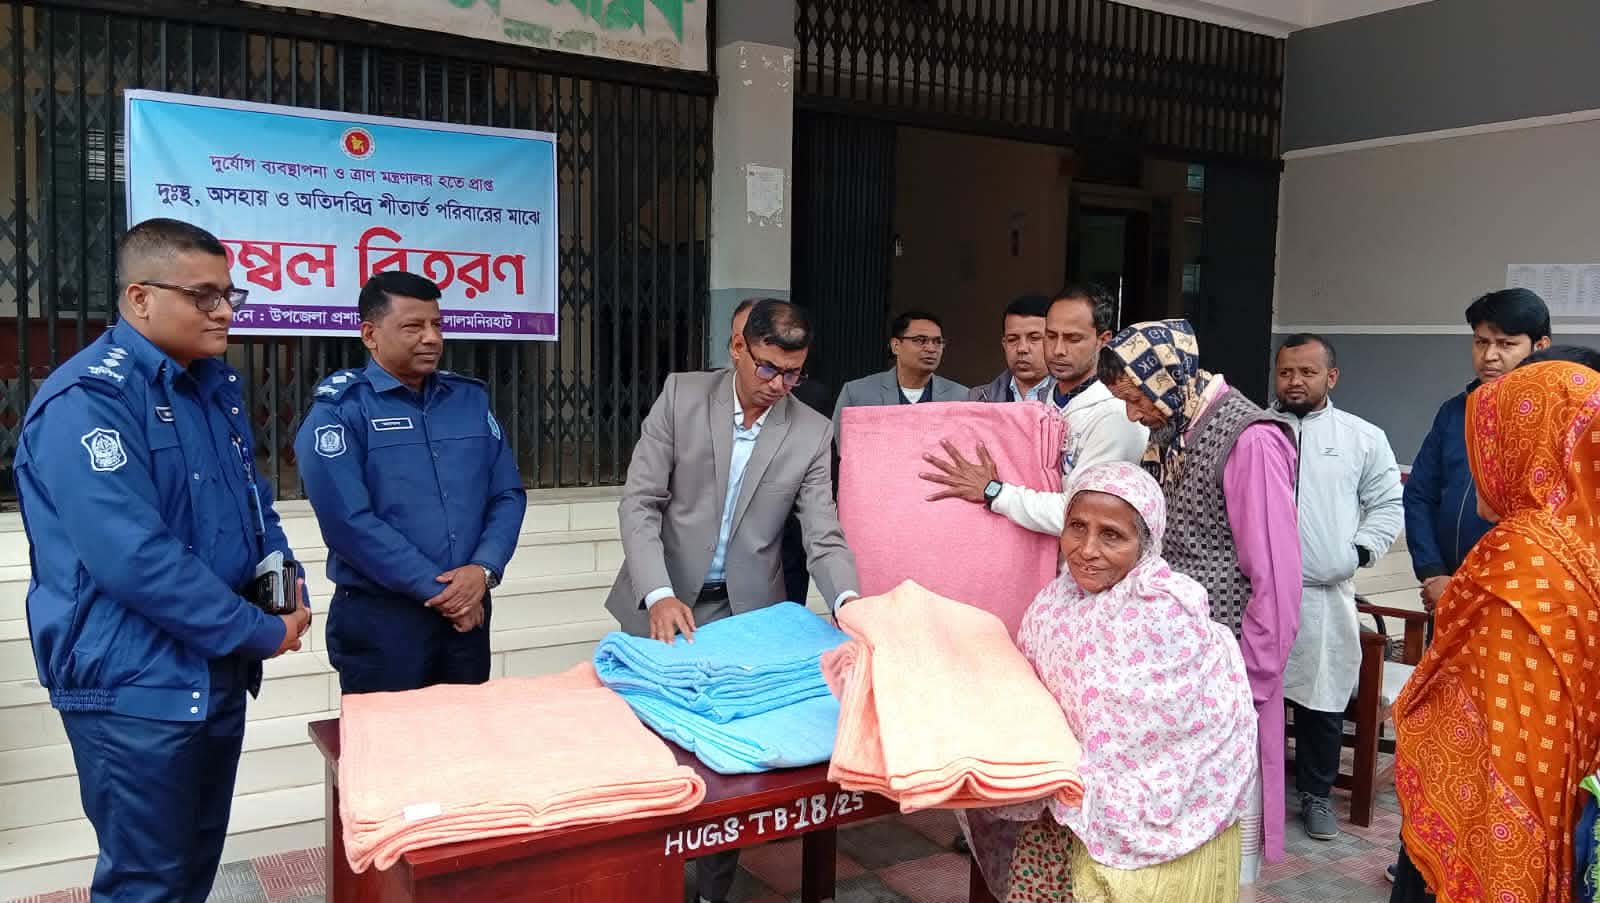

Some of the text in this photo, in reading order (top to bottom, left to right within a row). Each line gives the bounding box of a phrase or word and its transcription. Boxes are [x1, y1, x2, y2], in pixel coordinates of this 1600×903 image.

[209, 153, 494, 192] দুর্যোগ ব্যবস্থাপনা ও ত্রাণ মন্ত্রণালয় হতে প্রাপ্ত
[206, 187, 269, 207] অসহায়
[275, 192, 289, 206] ও
[296, 188, 372, 216] অতিদরিদ্র
[379, 192, 431, 217] শীতার্ত
[435, 199, 501, 224] পরিবারের
[507, 209, 540, 226] মাঝে
[354, 226, 527, 300] বিতরণ
[268, 306, 326, 324] উপজেলা
